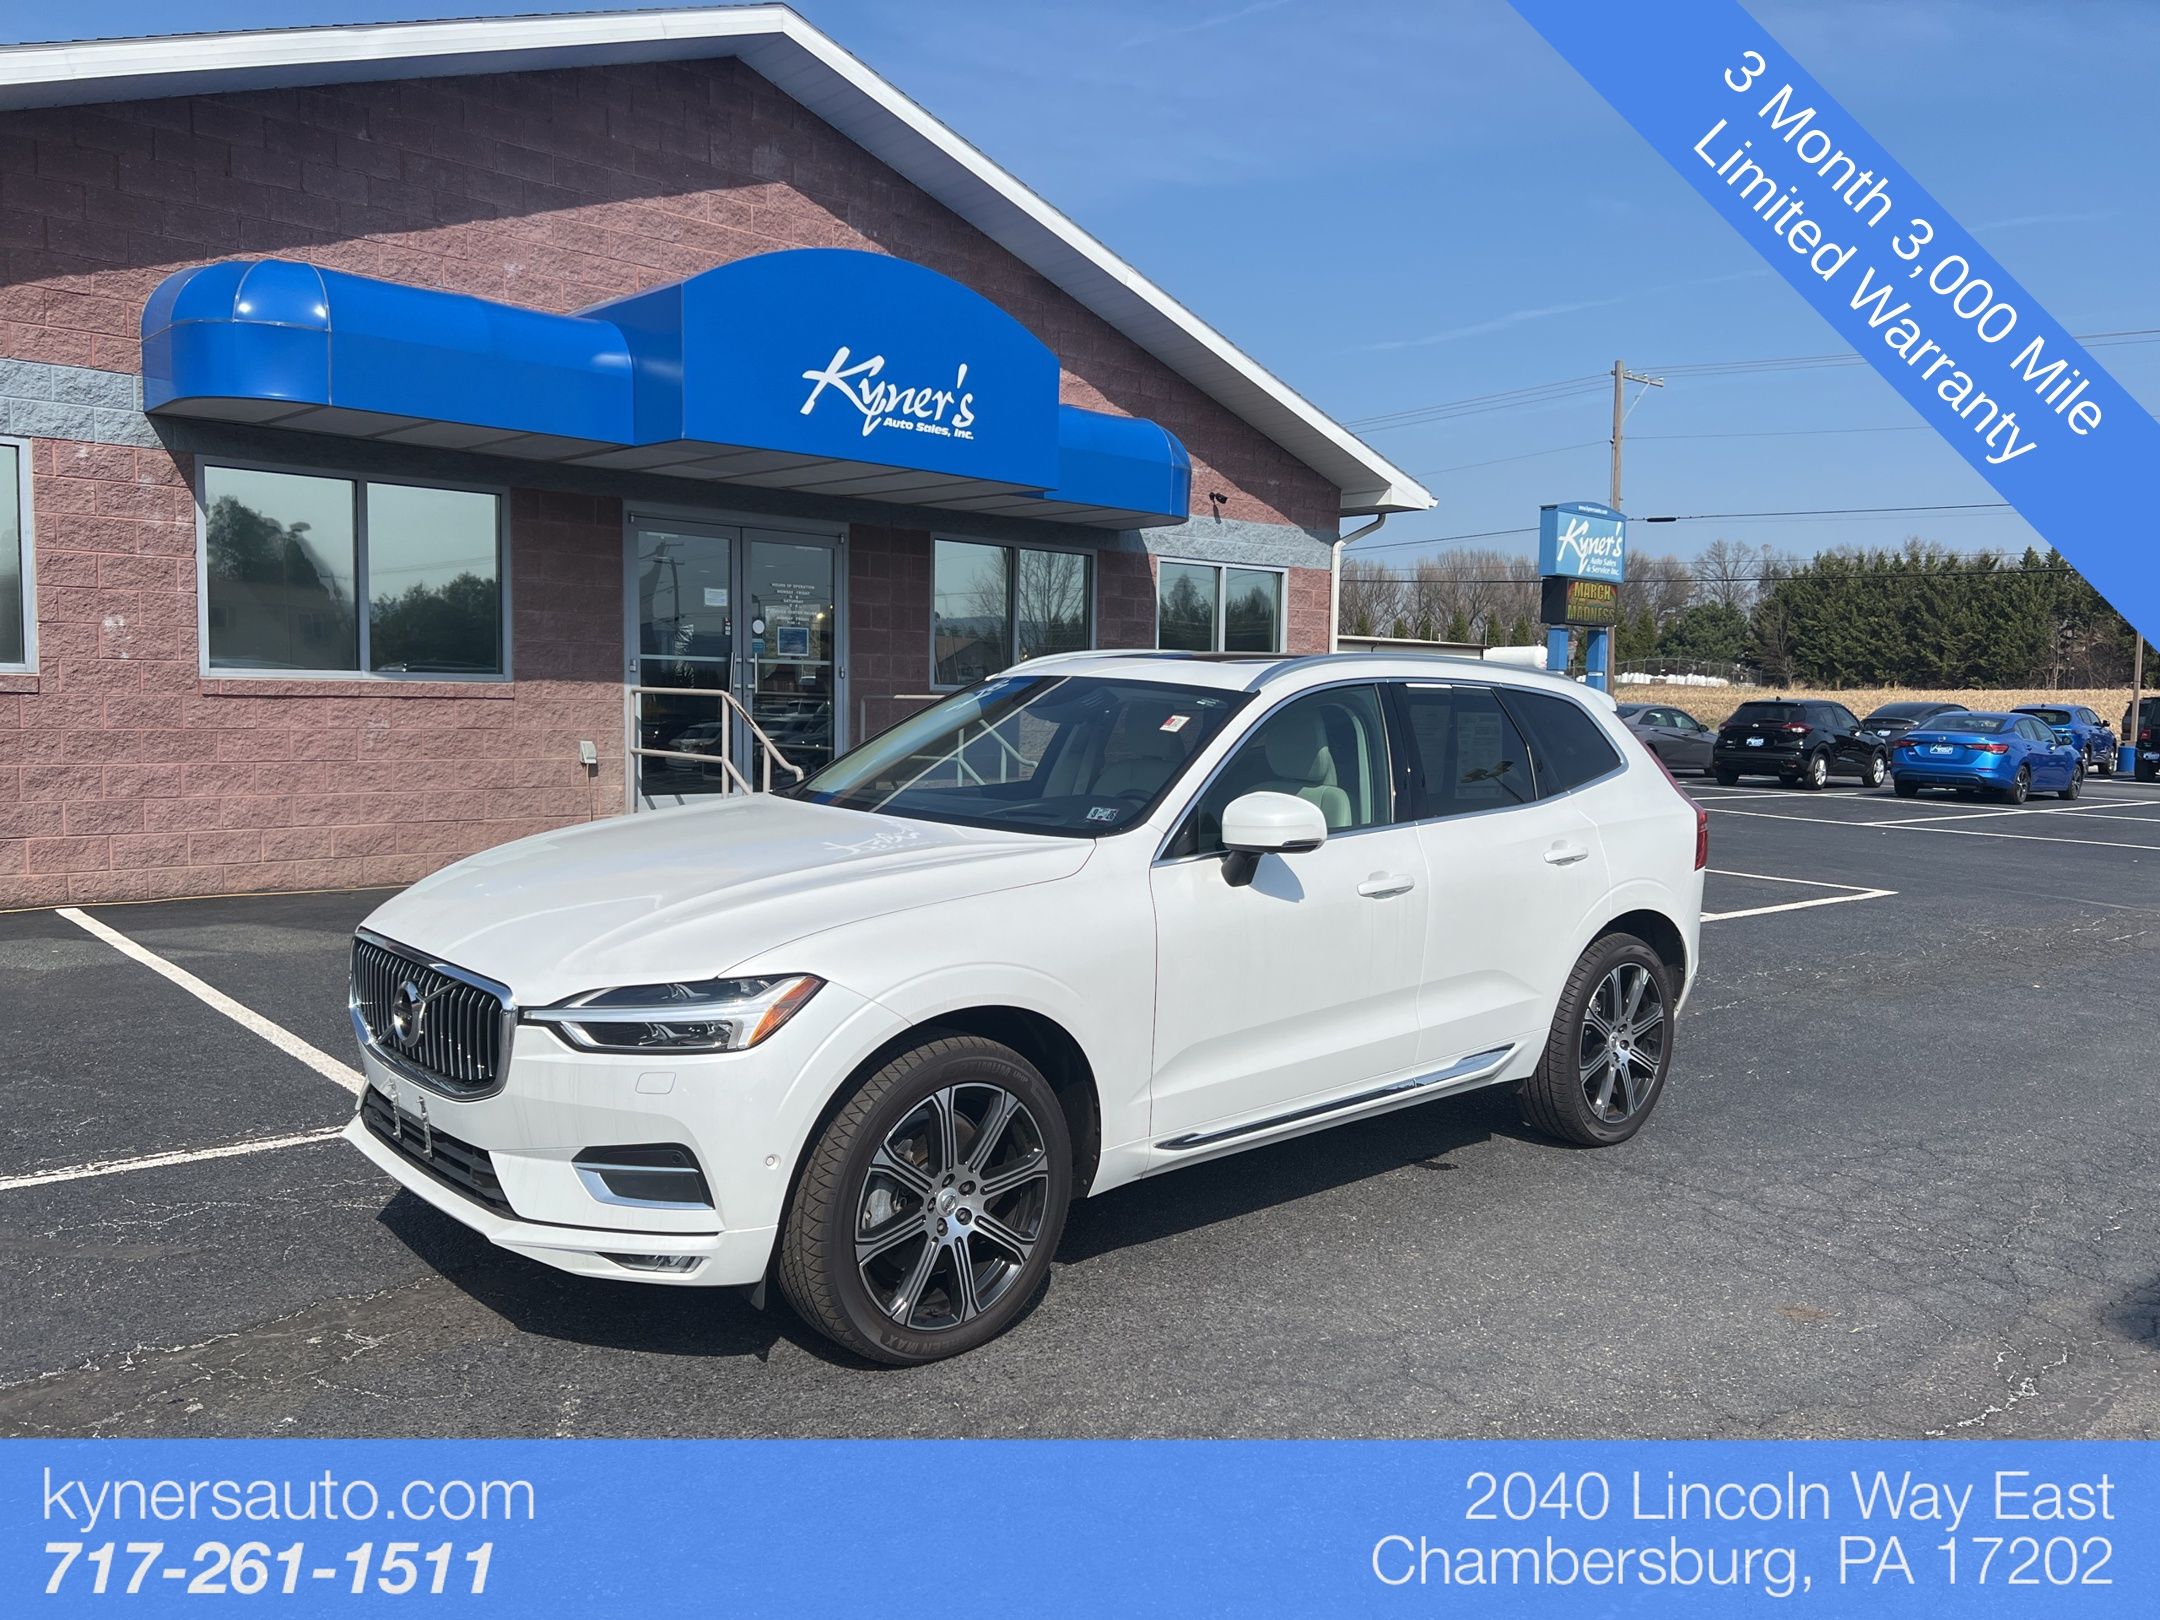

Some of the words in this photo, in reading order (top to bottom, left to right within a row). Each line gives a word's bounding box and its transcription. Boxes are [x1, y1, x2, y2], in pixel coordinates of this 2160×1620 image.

[799, 346, 975, 437] Kyner's
[883, 417, 914, 431] Auto
[915, 421, 951, 438] Sales,
[953, 428, 975, 440] Inc.
[1557, 517, 1623, 575] Kyner's
[1574, 581, 1611, 601] MARCH
[1567, 604, 1615, 623] MADNESS
